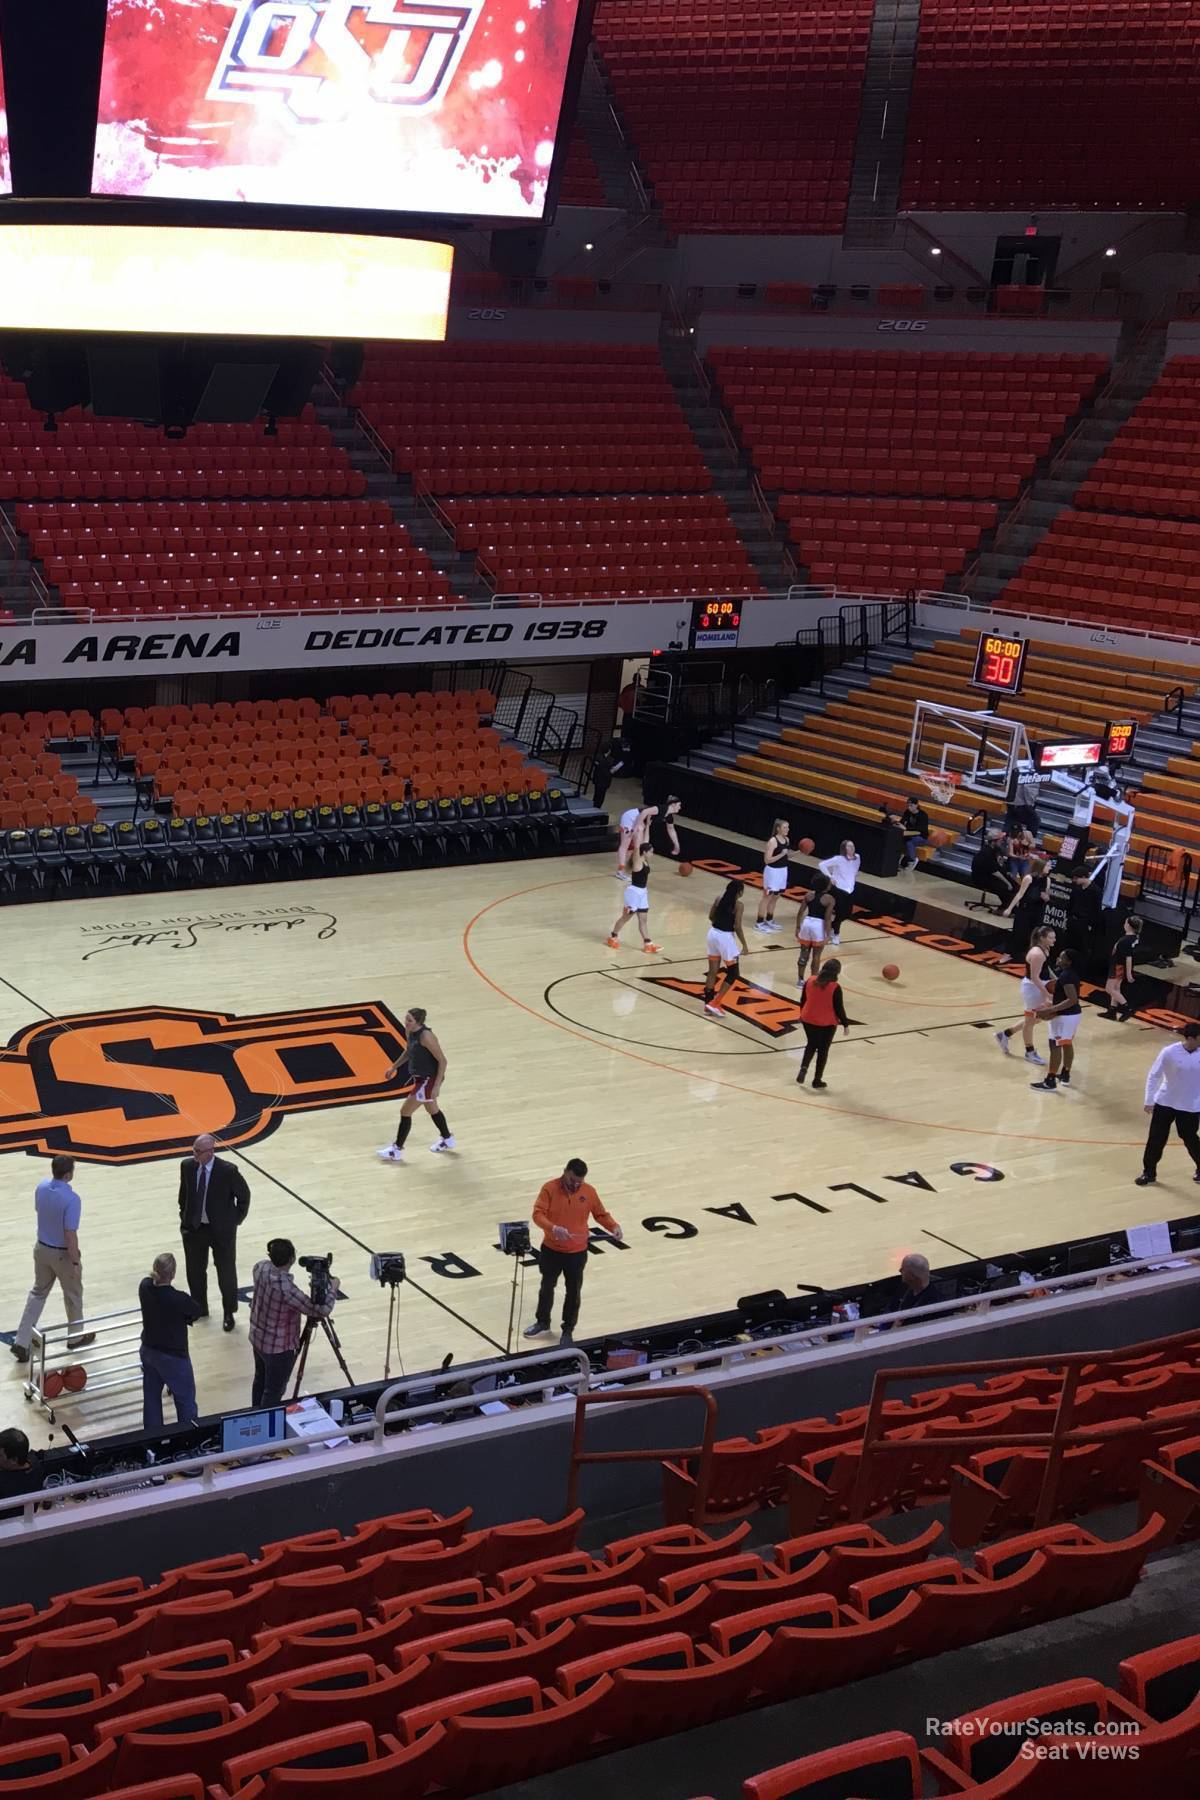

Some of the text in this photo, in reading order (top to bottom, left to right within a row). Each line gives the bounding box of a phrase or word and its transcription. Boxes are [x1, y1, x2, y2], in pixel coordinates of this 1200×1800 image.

[467, 308, 508, 320] 205
[877, 319, 929, 332] 206
[256, 619, 285, 630] 103
[62, 631, 241, 663] ARENA
[303, 623, 514, 651] DEDICATED
[523, 619, 608, 641] 1938
[696, 633, 736, 642] HOMELAND
[985, 638, 1021, 658] 60:00
[986, 654, 1014, 684] 30
[1110, 726, 1133, 737] 60:00
[1110, 738, 1127, 751] 30
[1017, 772, 1051, 785] tateFarm
[79, 921, 152, 933] COURT
